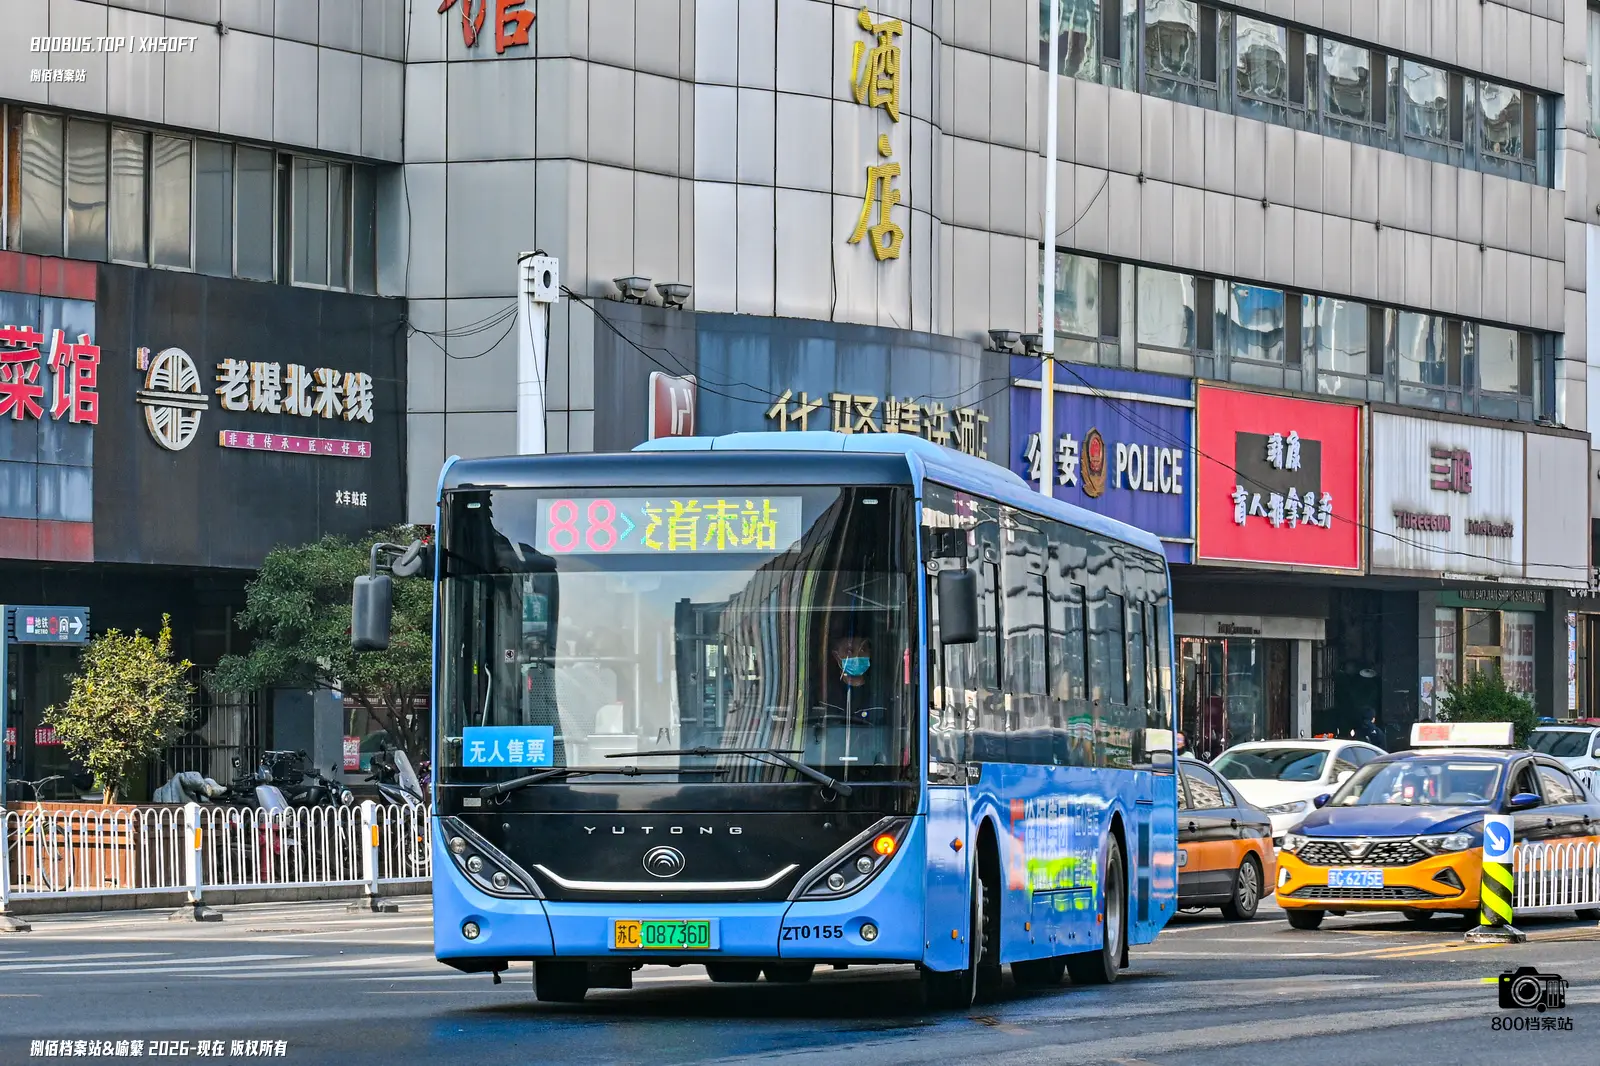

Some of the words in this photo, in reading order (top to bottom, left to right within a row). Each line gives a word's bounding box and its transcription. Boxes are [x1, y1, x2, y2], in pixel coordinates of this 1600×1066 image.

[847, 6, 904, 262] 酒店
[0, 325, 101, 424] 菜馆
[1114, 442, 1184, 495] POLICE
[335, 490, 368, 507] 火车站店
[547, 499, 618, 553] 88
[469, 738, 546, 764] 无人售票
[583, 825, 744, 835] YUTONG
[781, 924, 844, 941] ZT0155
